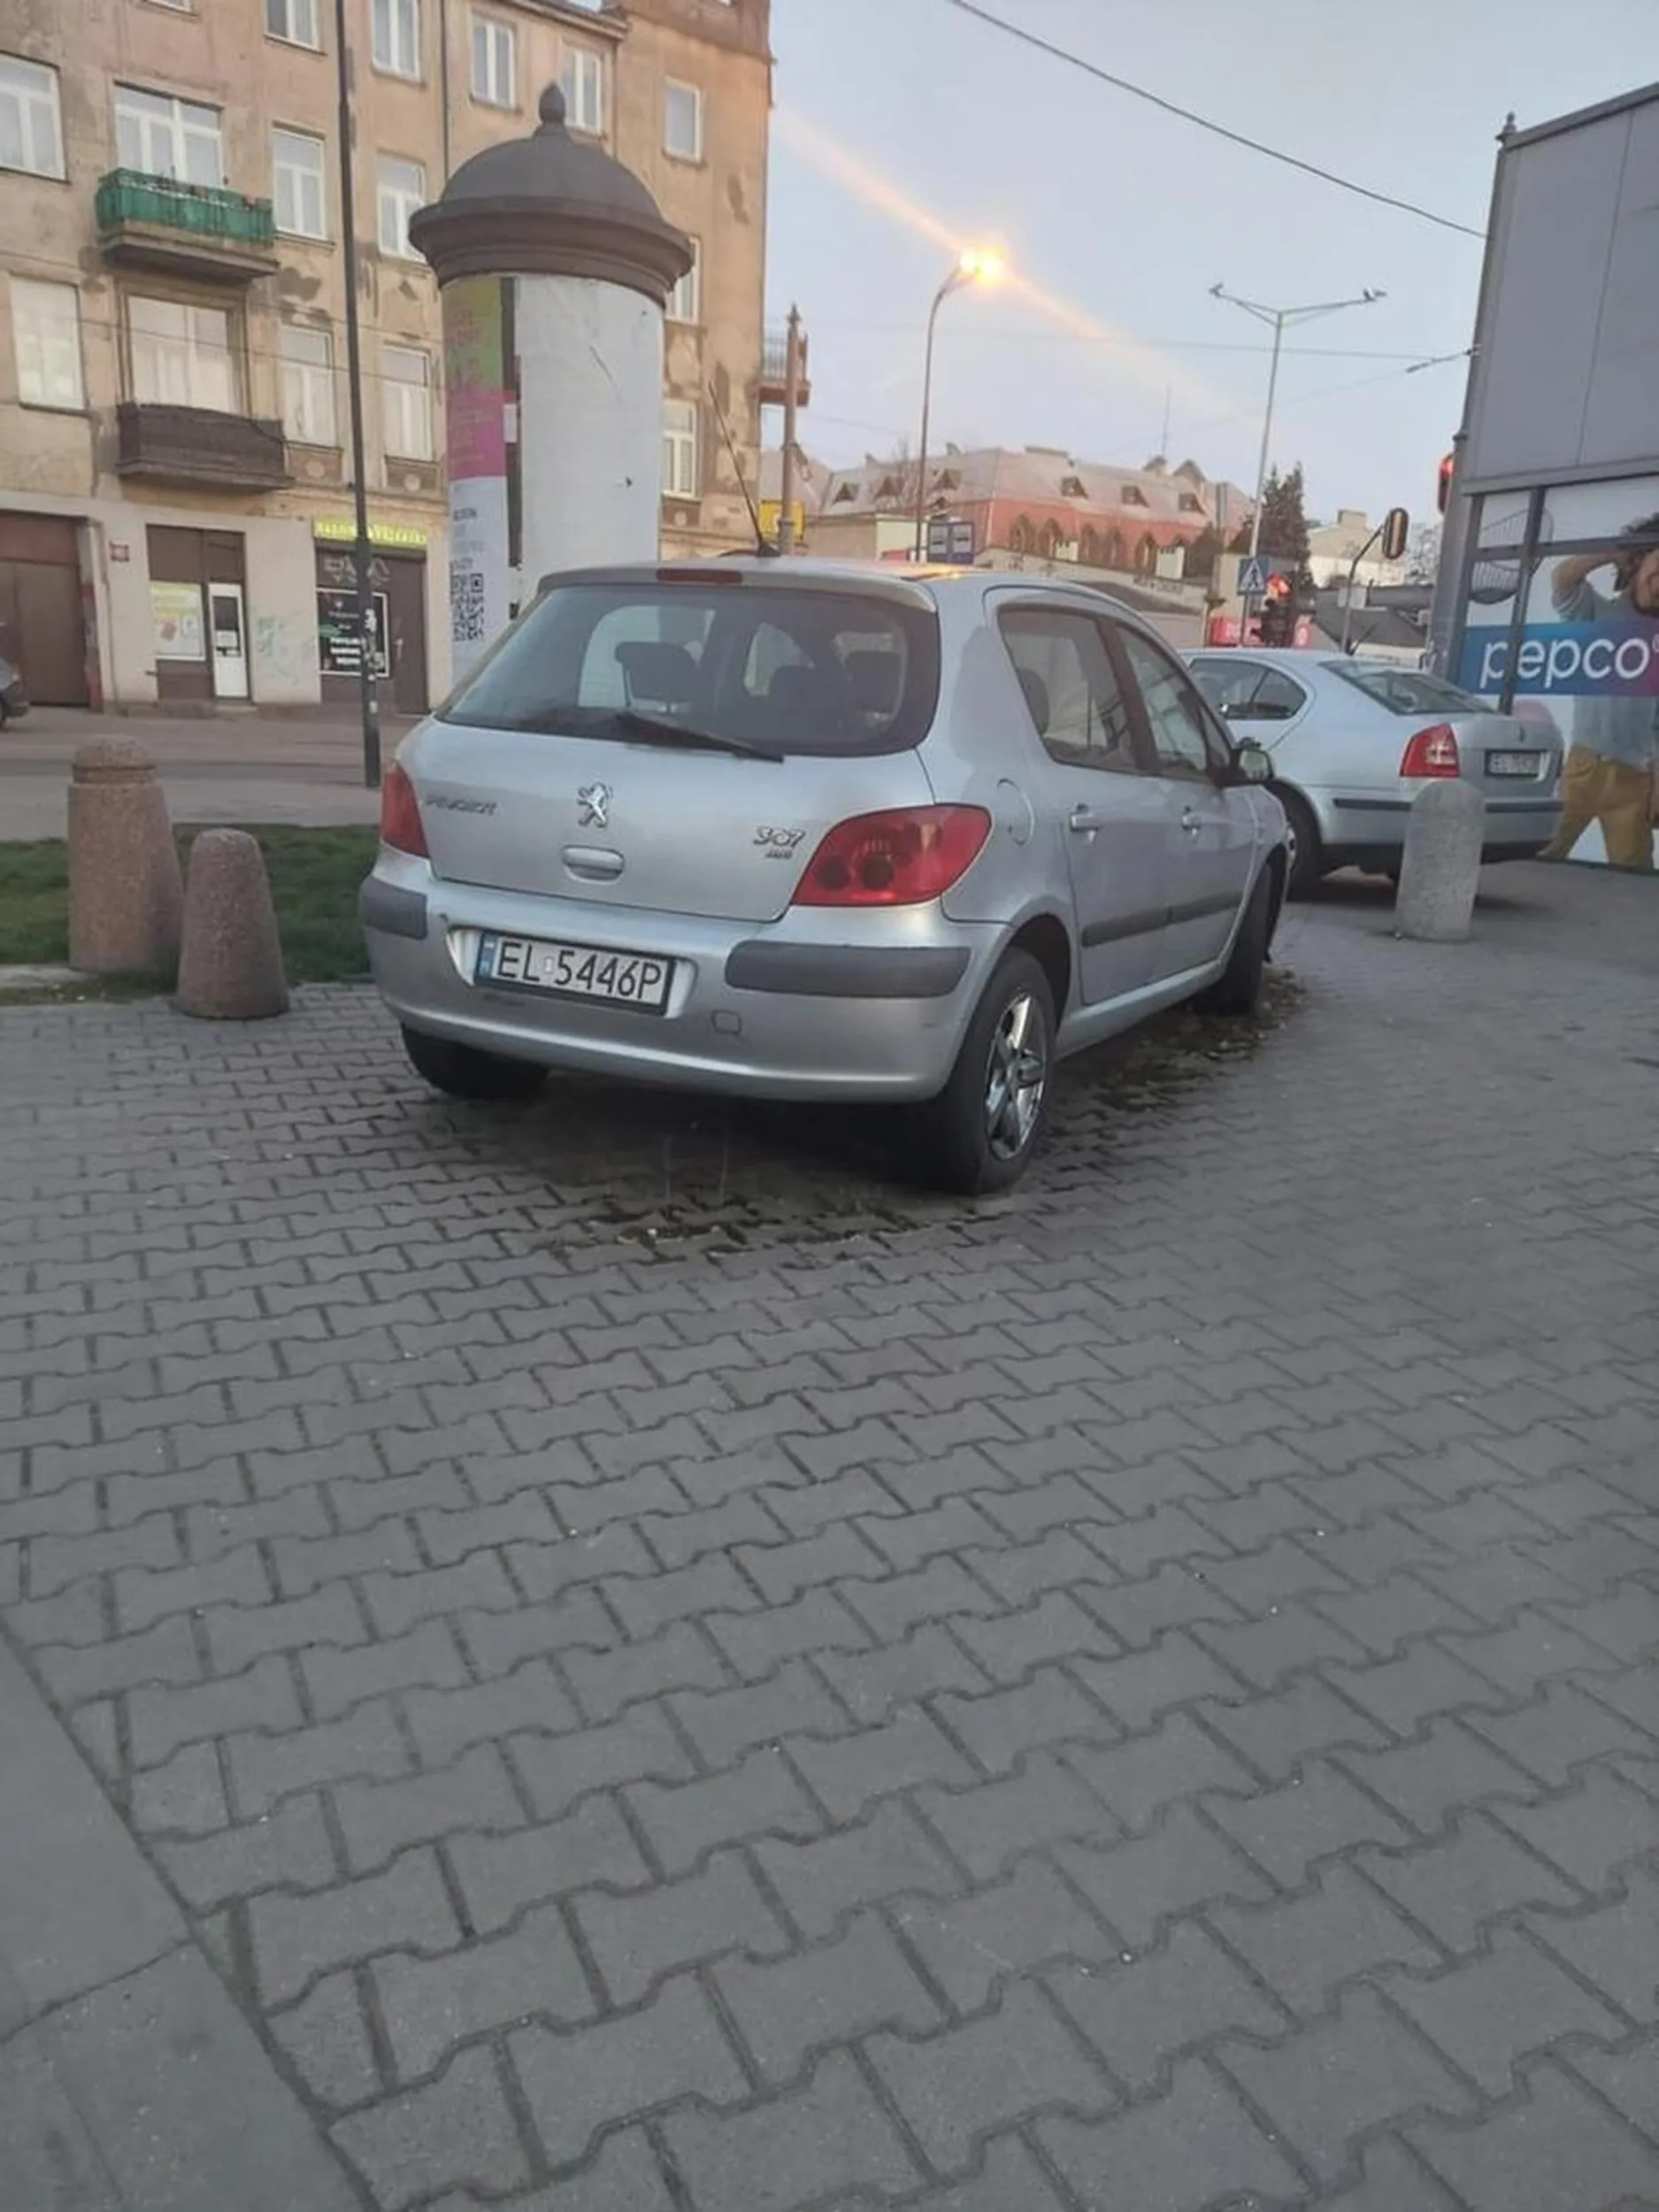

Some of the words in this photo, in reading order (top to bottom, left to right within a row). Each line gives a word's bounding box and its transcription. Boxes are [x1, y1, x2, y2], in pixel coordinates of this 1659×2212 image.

[1479, 637, 1650, 689] pepco
[752, 826, 806, 849] 307
[497, 941, 541, 982] EL
[554, 949, 662, 1000] 5446P
